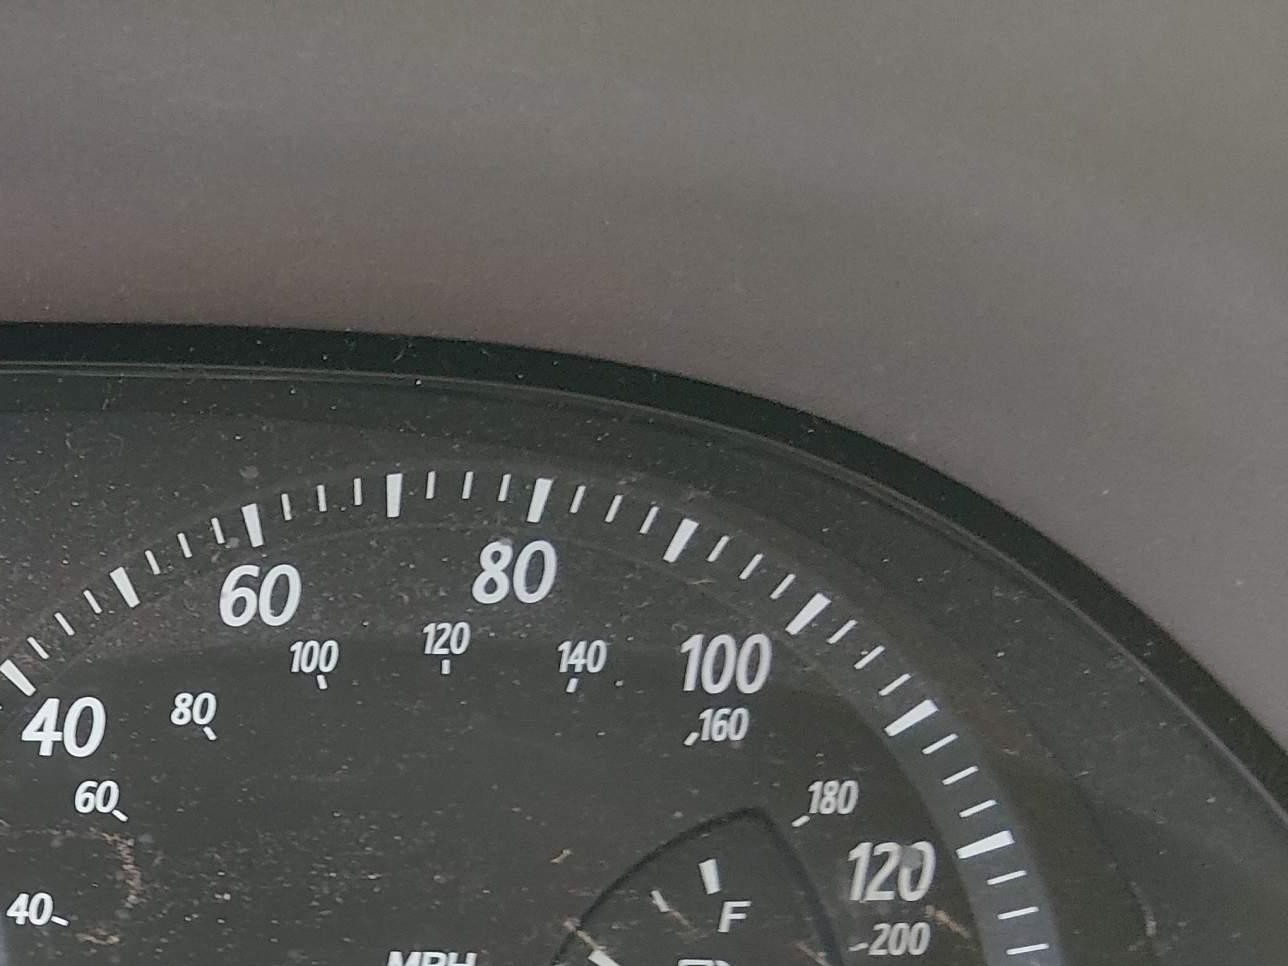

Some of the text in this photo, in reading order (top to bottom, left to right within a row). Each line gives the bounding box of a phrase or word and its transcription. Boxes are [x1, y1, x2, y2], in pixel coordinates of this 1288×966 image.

[472, 540, 557, 604] 80
[219, 564, 302, 627] 60
[423, 621, 470, 655] 120
[290, 640, 339, 673] 100
[558, 640, 607, 673] 140
[680, 633, 772, 694] 100
[170, 692, 217, 725] 80
[697, 707, 749, 742] 160
[21, 696, 106, 758] 40
[74, 780, 120, 815] 60
[808, 780, 859, 815] 180
[847, 841, 936, 902] 120
[6, 892, 53, 925] 40
[718, 901, 751, 932] F
[868, 922, 930, 956] 200
